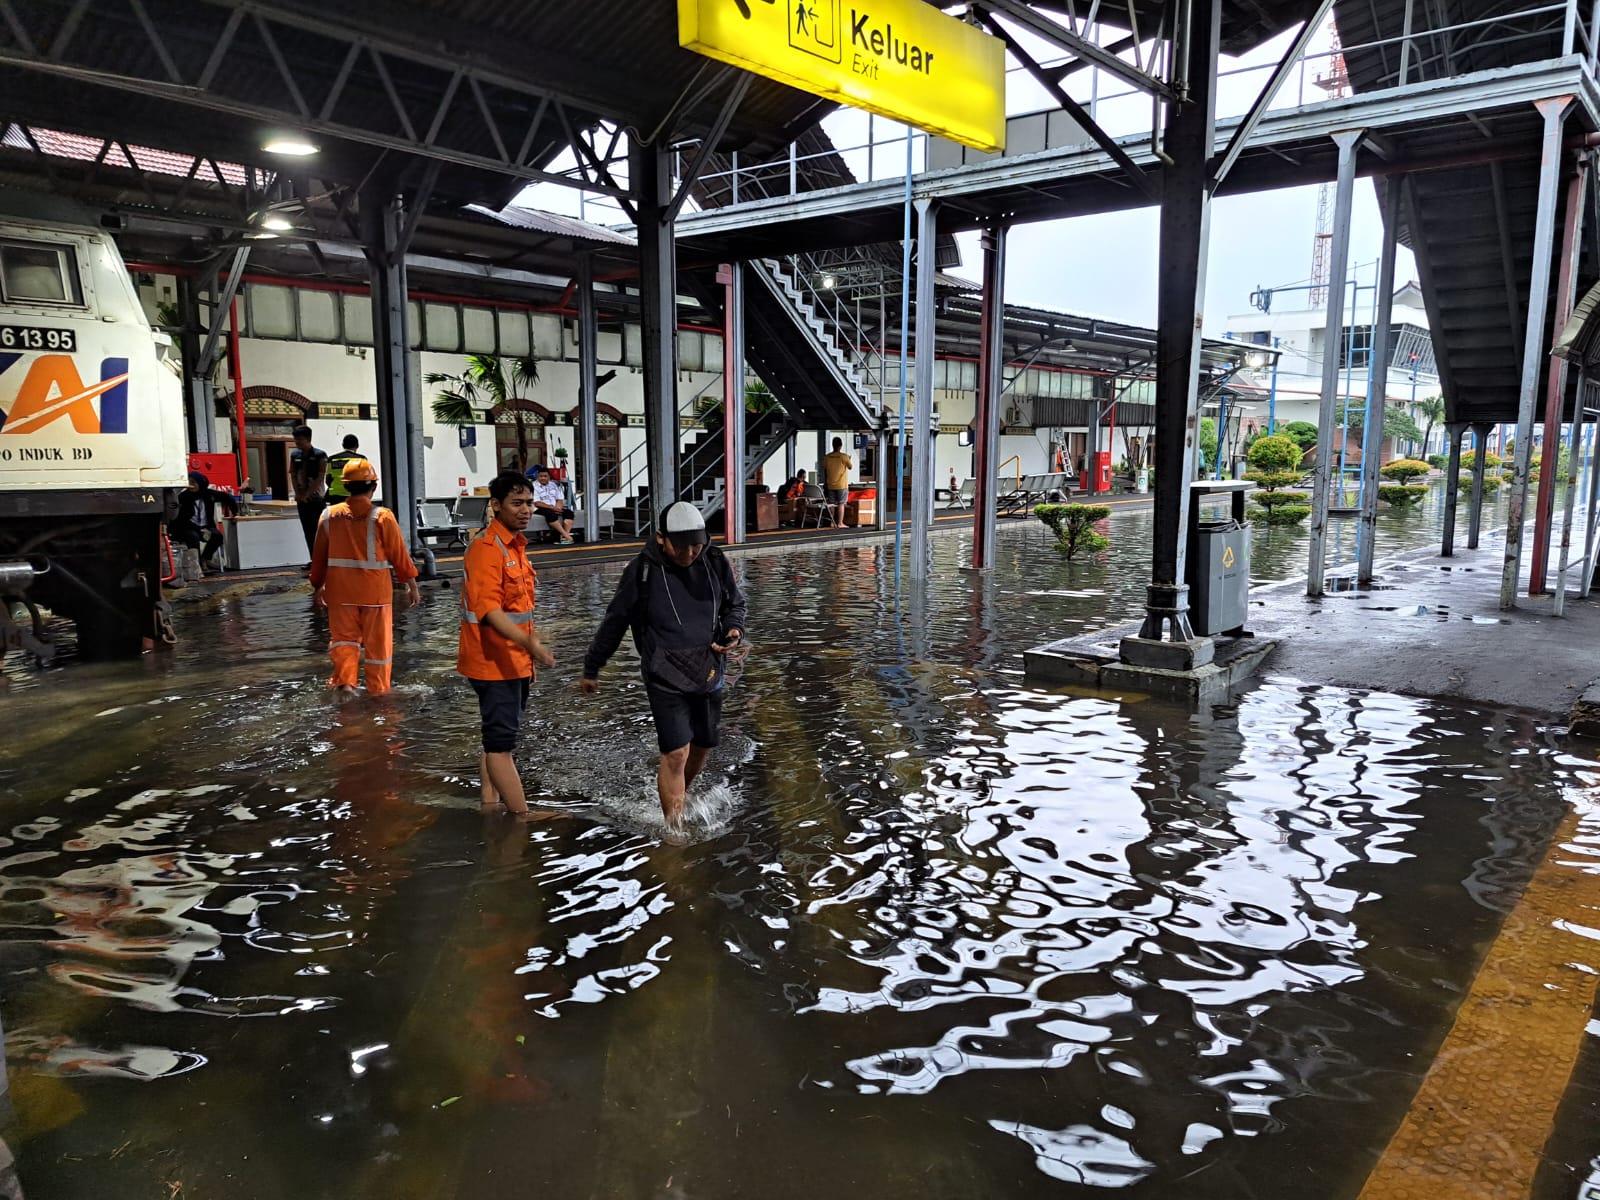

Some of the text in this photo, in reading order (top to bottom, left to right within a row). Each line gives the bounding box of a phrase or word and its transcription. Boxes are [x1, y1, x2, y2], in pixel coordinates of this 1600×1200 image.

[851, 9, 934, 75] Keluar
[852, 53, 879, 80] Exit
[19, 328, 43, 347] 13
[46, 330, 73, 349] 95
[19, 448, 64, 461] INDUK
[72, 447, 93, 460] BD
[141, 494, 156, 503] 1A
